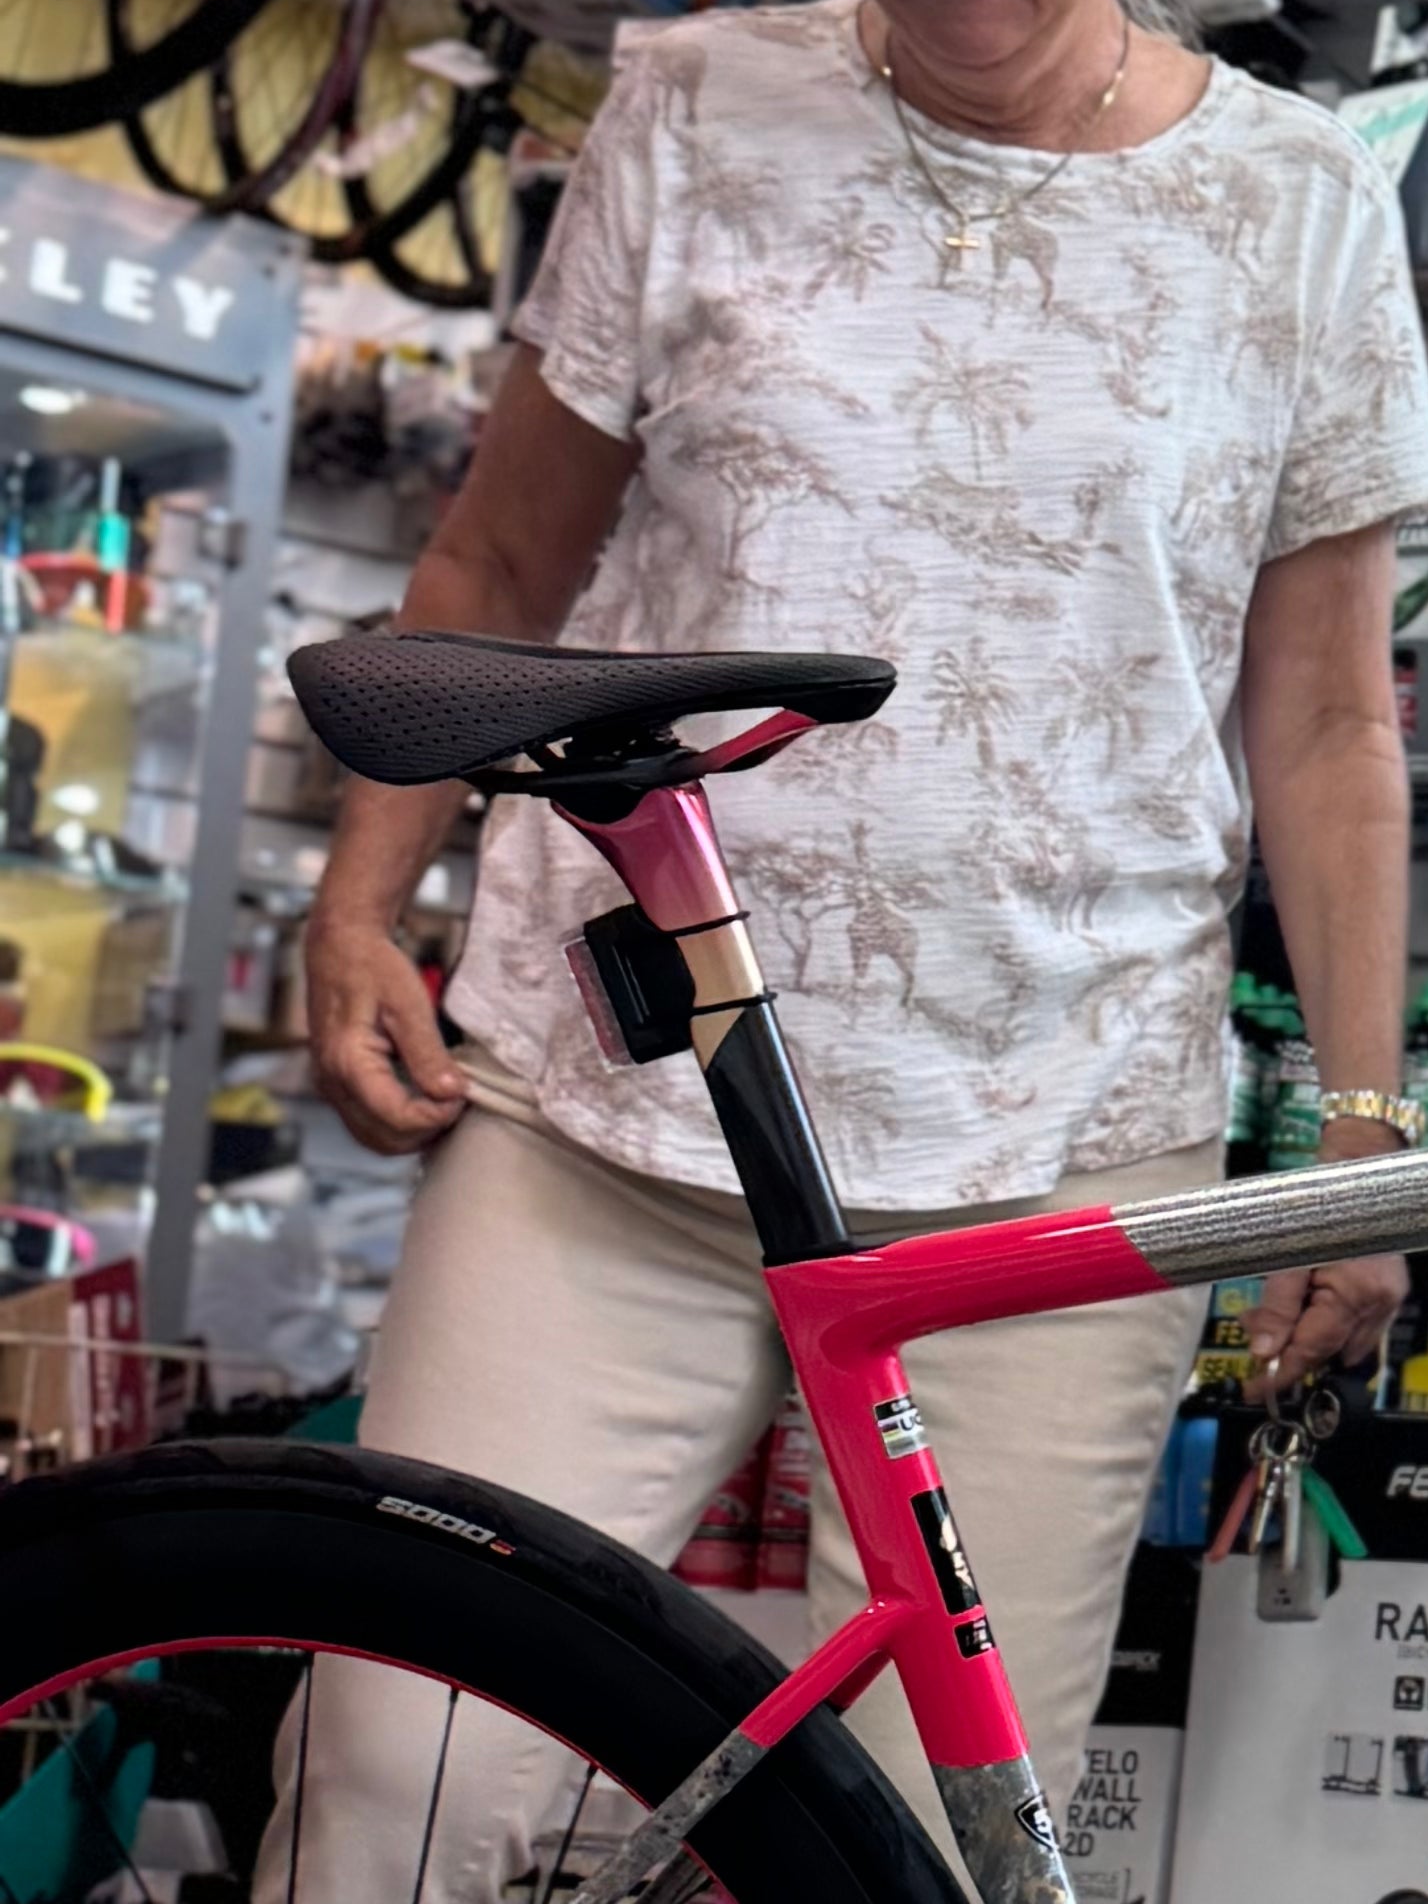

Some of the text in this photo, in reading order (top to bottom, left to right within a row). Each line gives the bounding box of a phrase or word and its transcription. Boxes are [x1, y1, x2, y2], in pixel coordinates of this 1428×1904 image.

[0, 224, 236, 343] LEY
[375, 1494, 498, 1547] 5000
[1084, 1748, 1139, 1776] ELO
[1066, 1803, 1138, 1832] RACK
